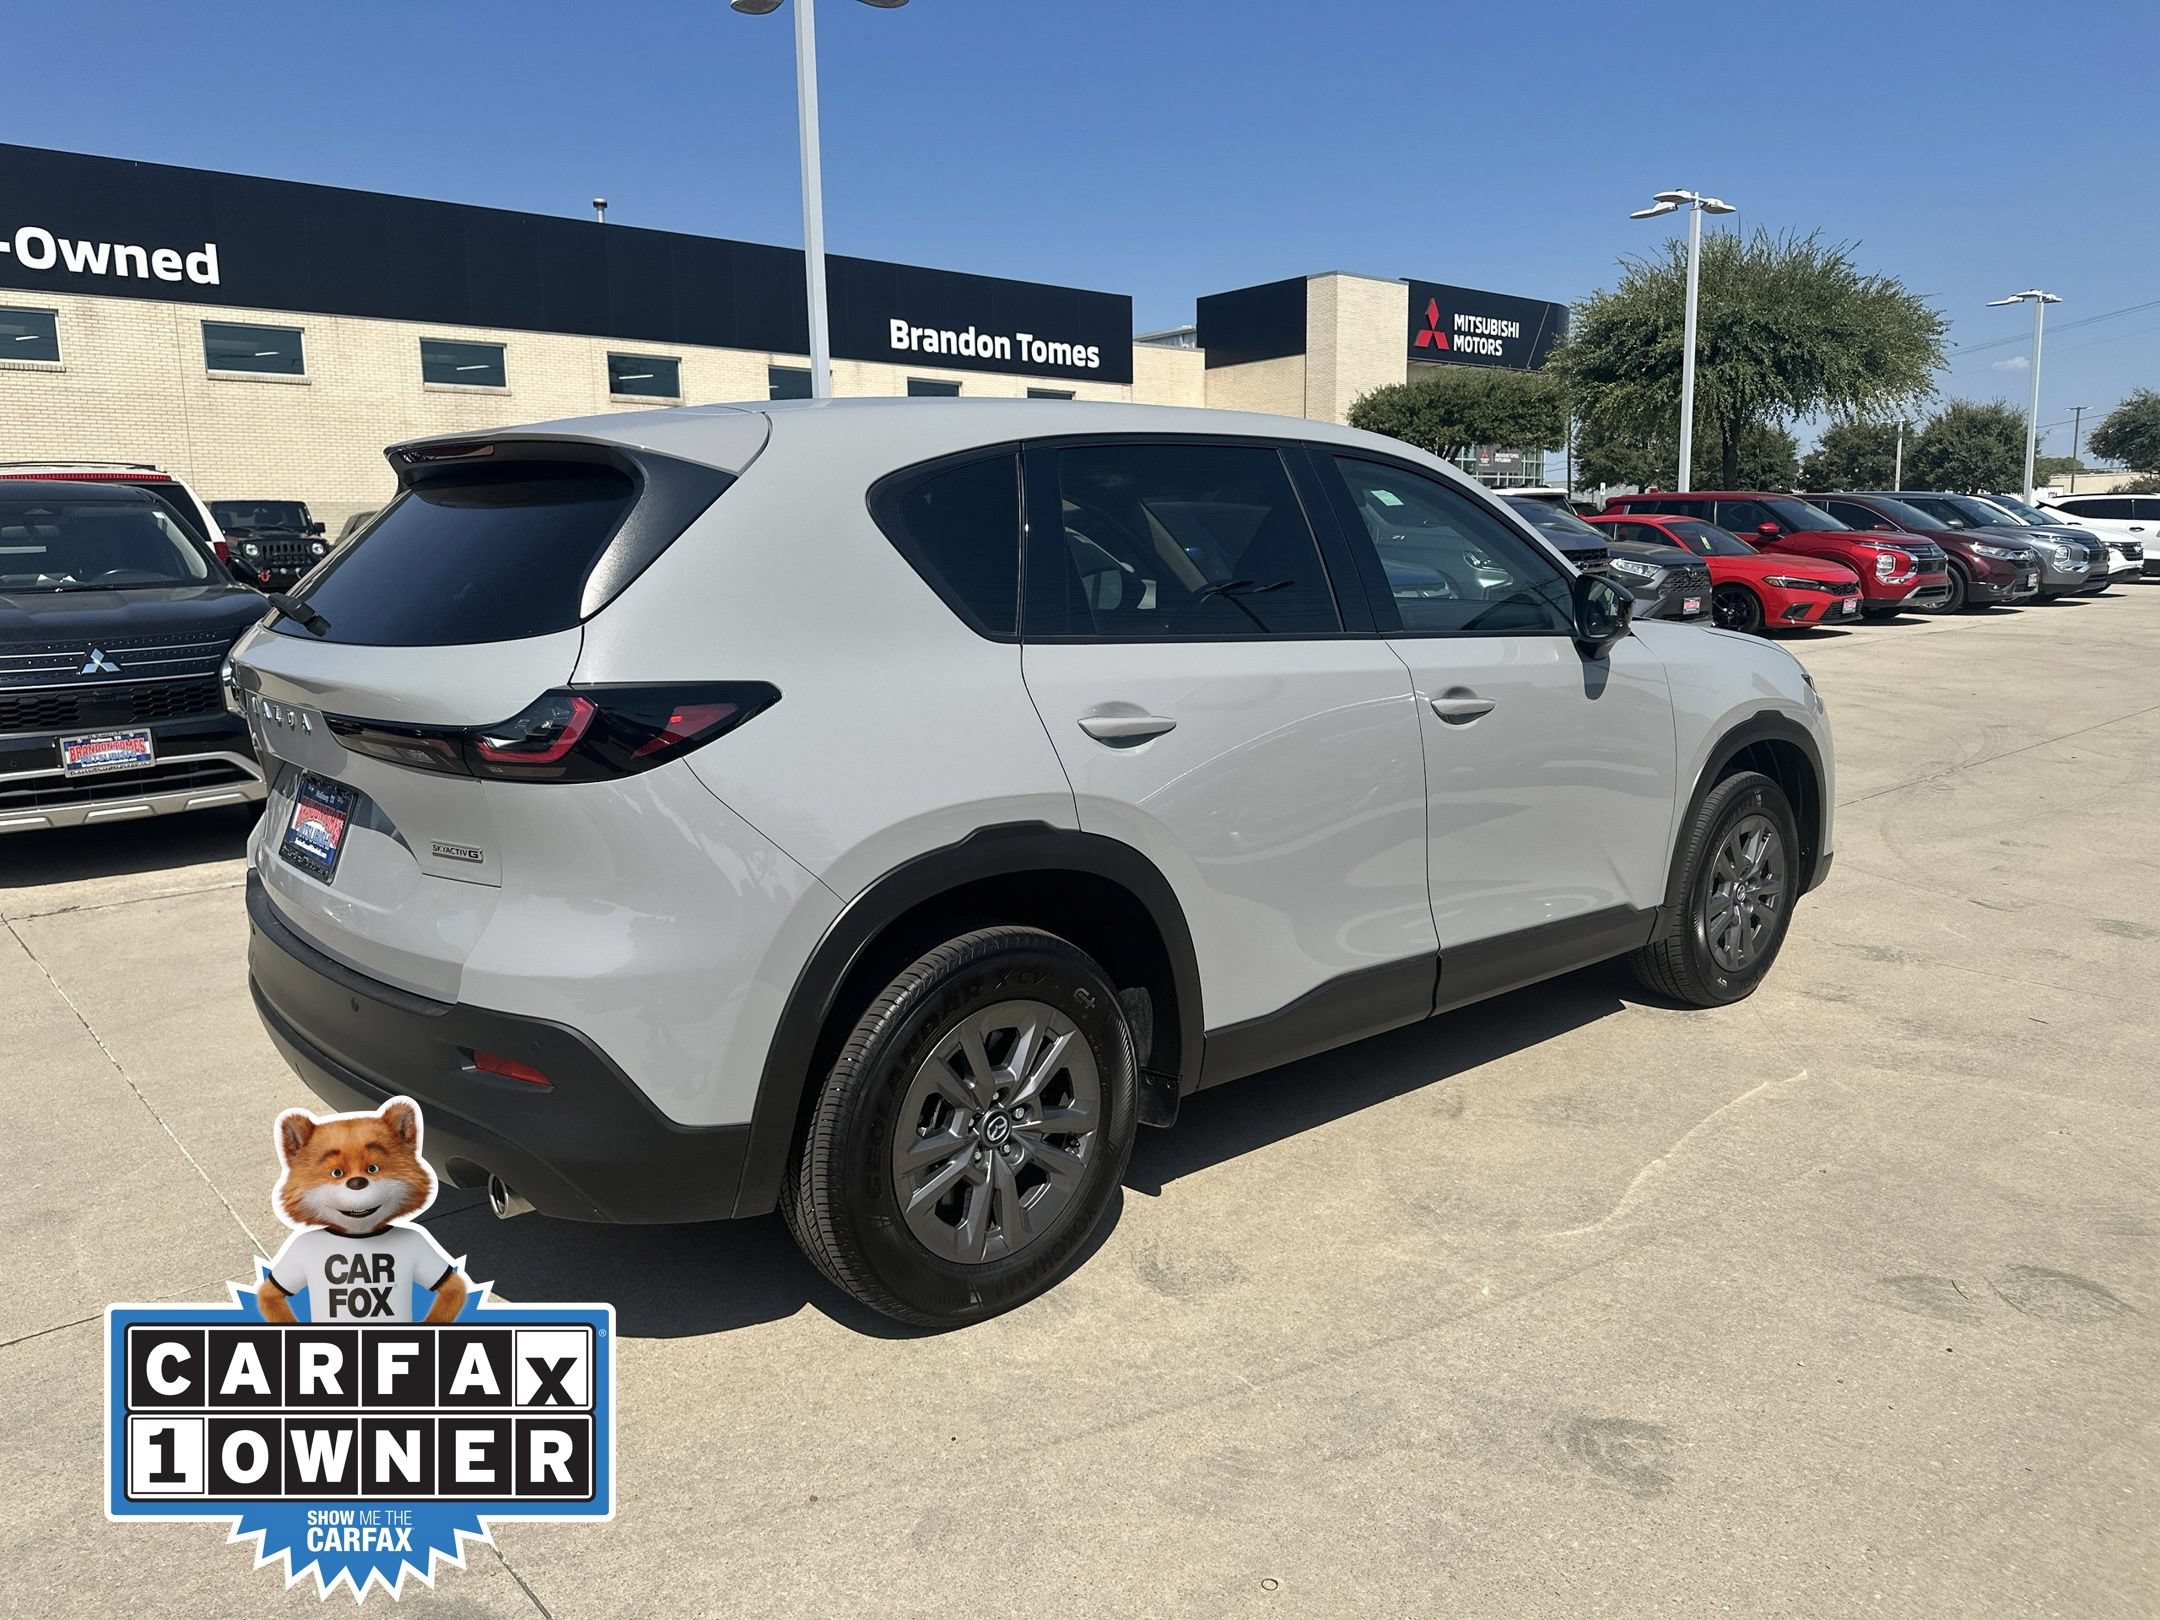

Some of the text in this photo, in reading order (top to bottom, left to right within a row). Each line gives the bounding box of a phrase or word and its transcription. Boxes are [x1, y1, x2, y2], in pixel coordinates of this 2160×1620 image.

[1454, 313, 1519, 339] MITSUBISHI
[889, 318, 1100, 368] Brandon Tomes
[1453, 334, 1503, 356] MOTORS
[69, 744, 112, 764] BRANDON
